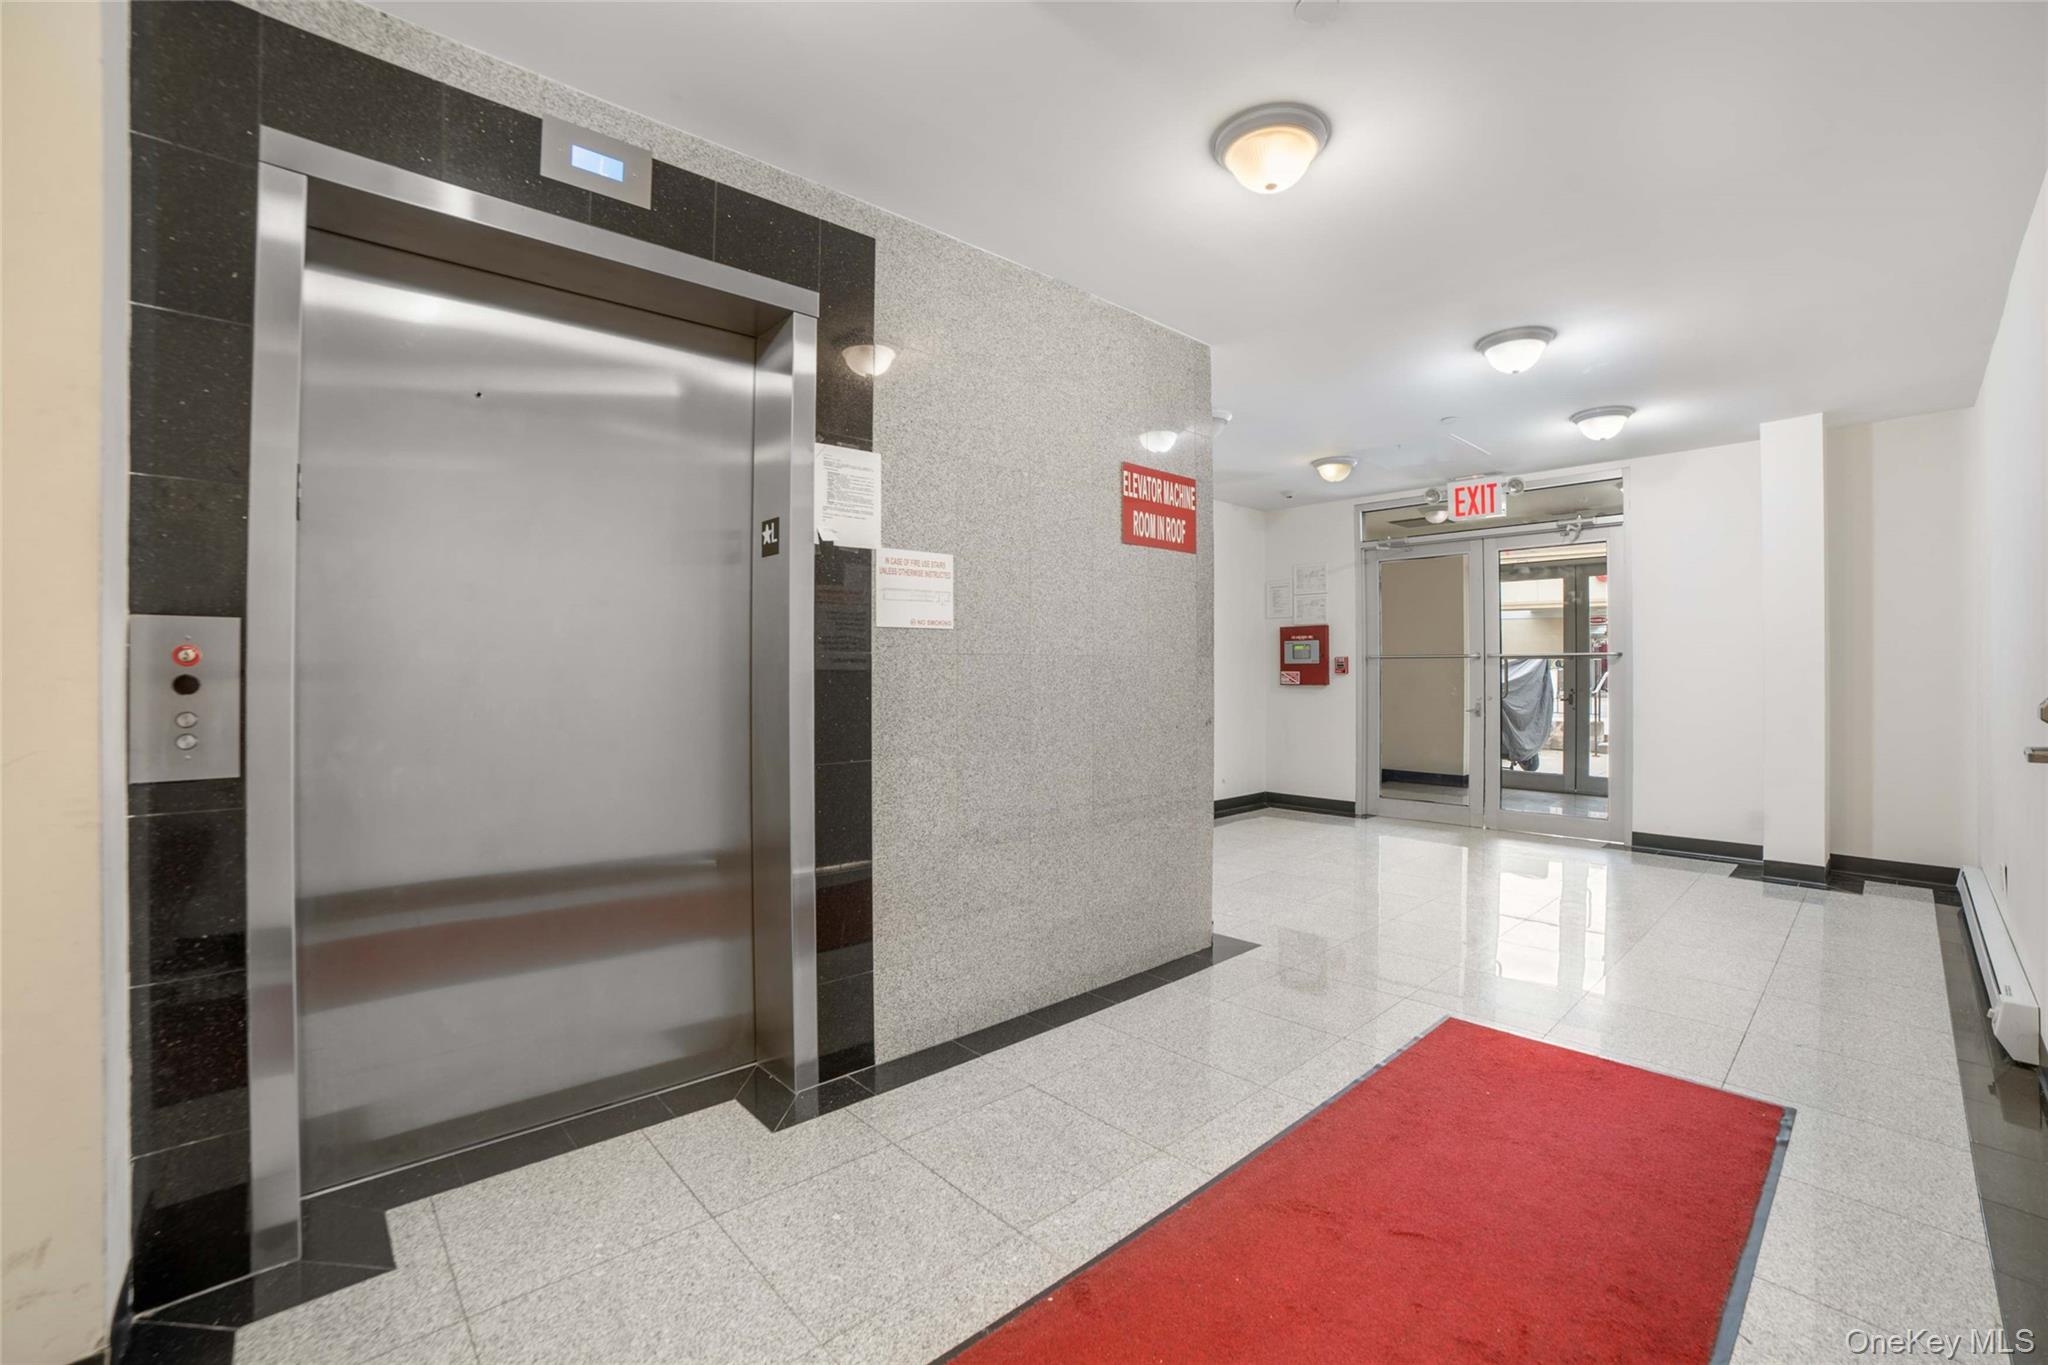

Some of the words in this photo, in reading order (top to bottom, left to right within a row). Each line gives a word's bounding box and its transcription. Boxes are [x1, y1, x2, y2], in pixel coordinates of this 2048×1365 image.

[1123, 470, 1163, 504] ELEVATOR
[1163, 480, 1196, 511] MACHINE
[1455, 483, 1497, 517] EXIT
[1133, 510, 1156, 539] ROOM
[1157, 514, 1165, 541] IN
[1165, 516, 1186, 544] ROOF
